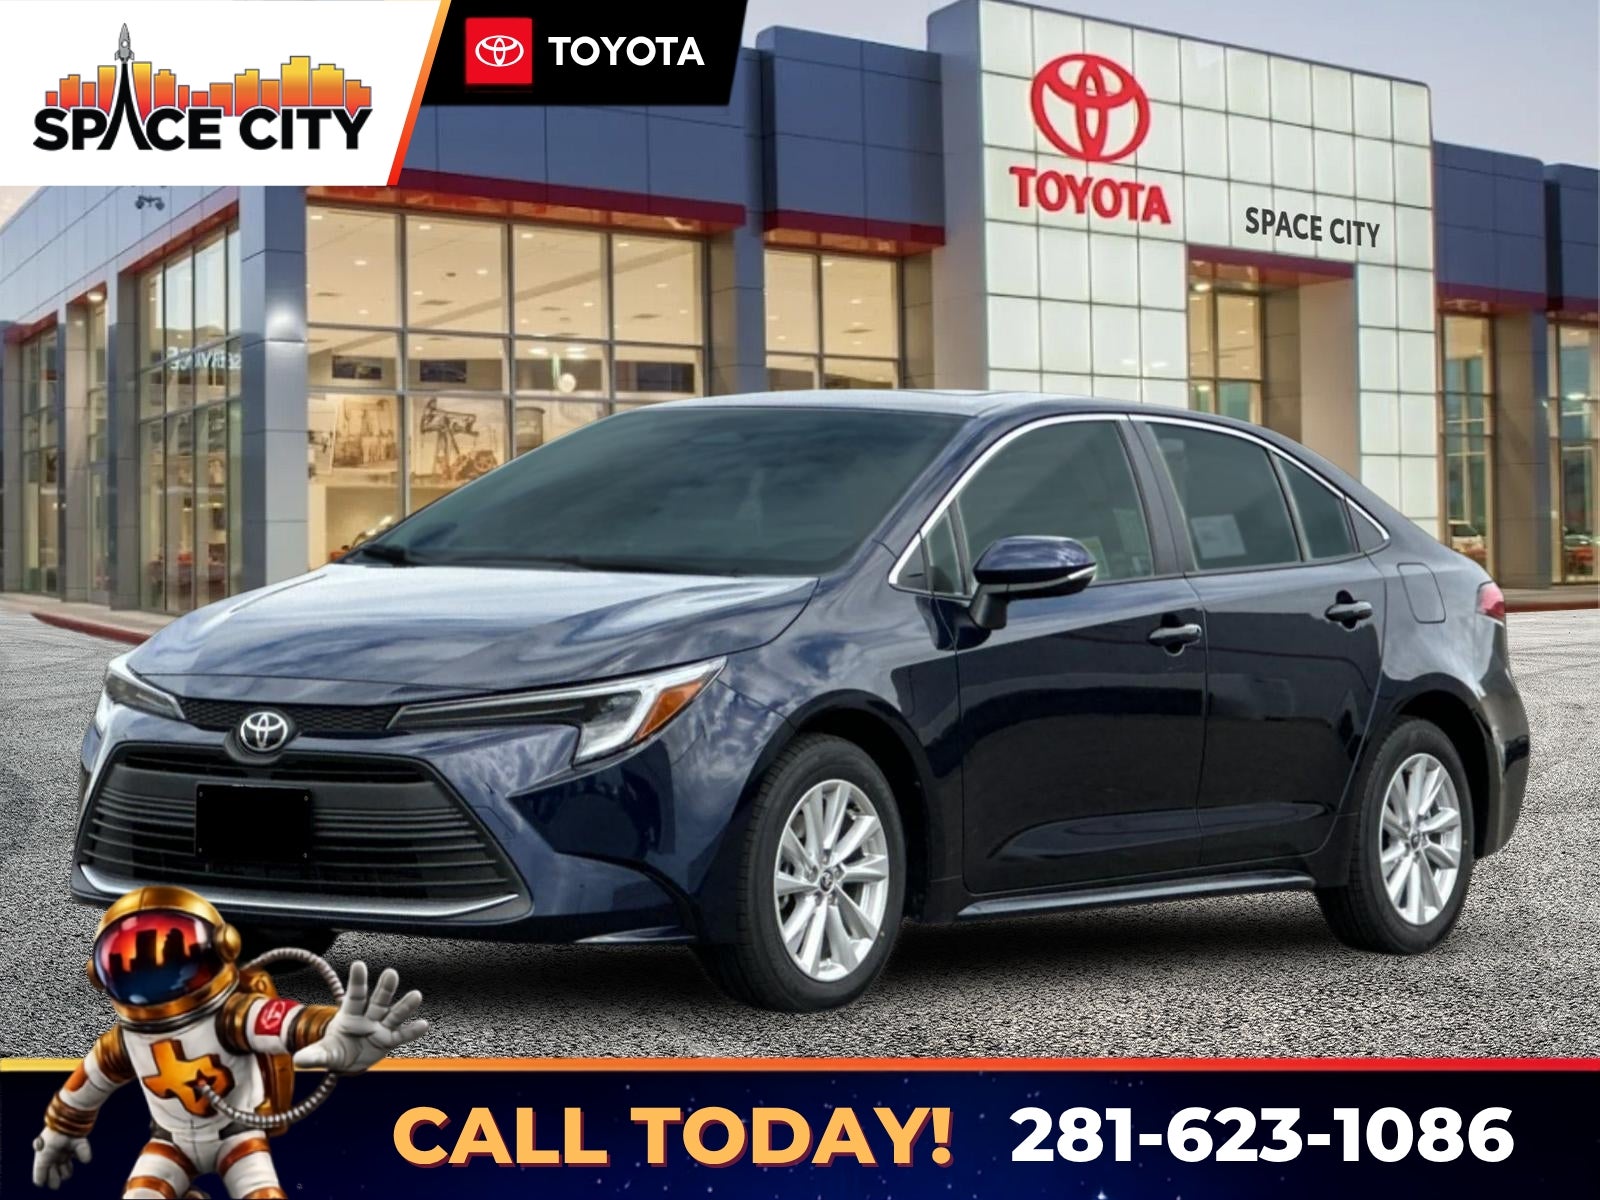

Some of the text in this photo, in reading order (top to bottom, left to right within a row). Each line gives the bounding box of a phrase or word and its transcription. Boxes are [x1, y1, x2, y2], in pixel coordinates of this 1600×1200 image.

[1009, 166, 1171, 224] TOYOTA
[1245, 206, 1381, 248] SPACE CITY
